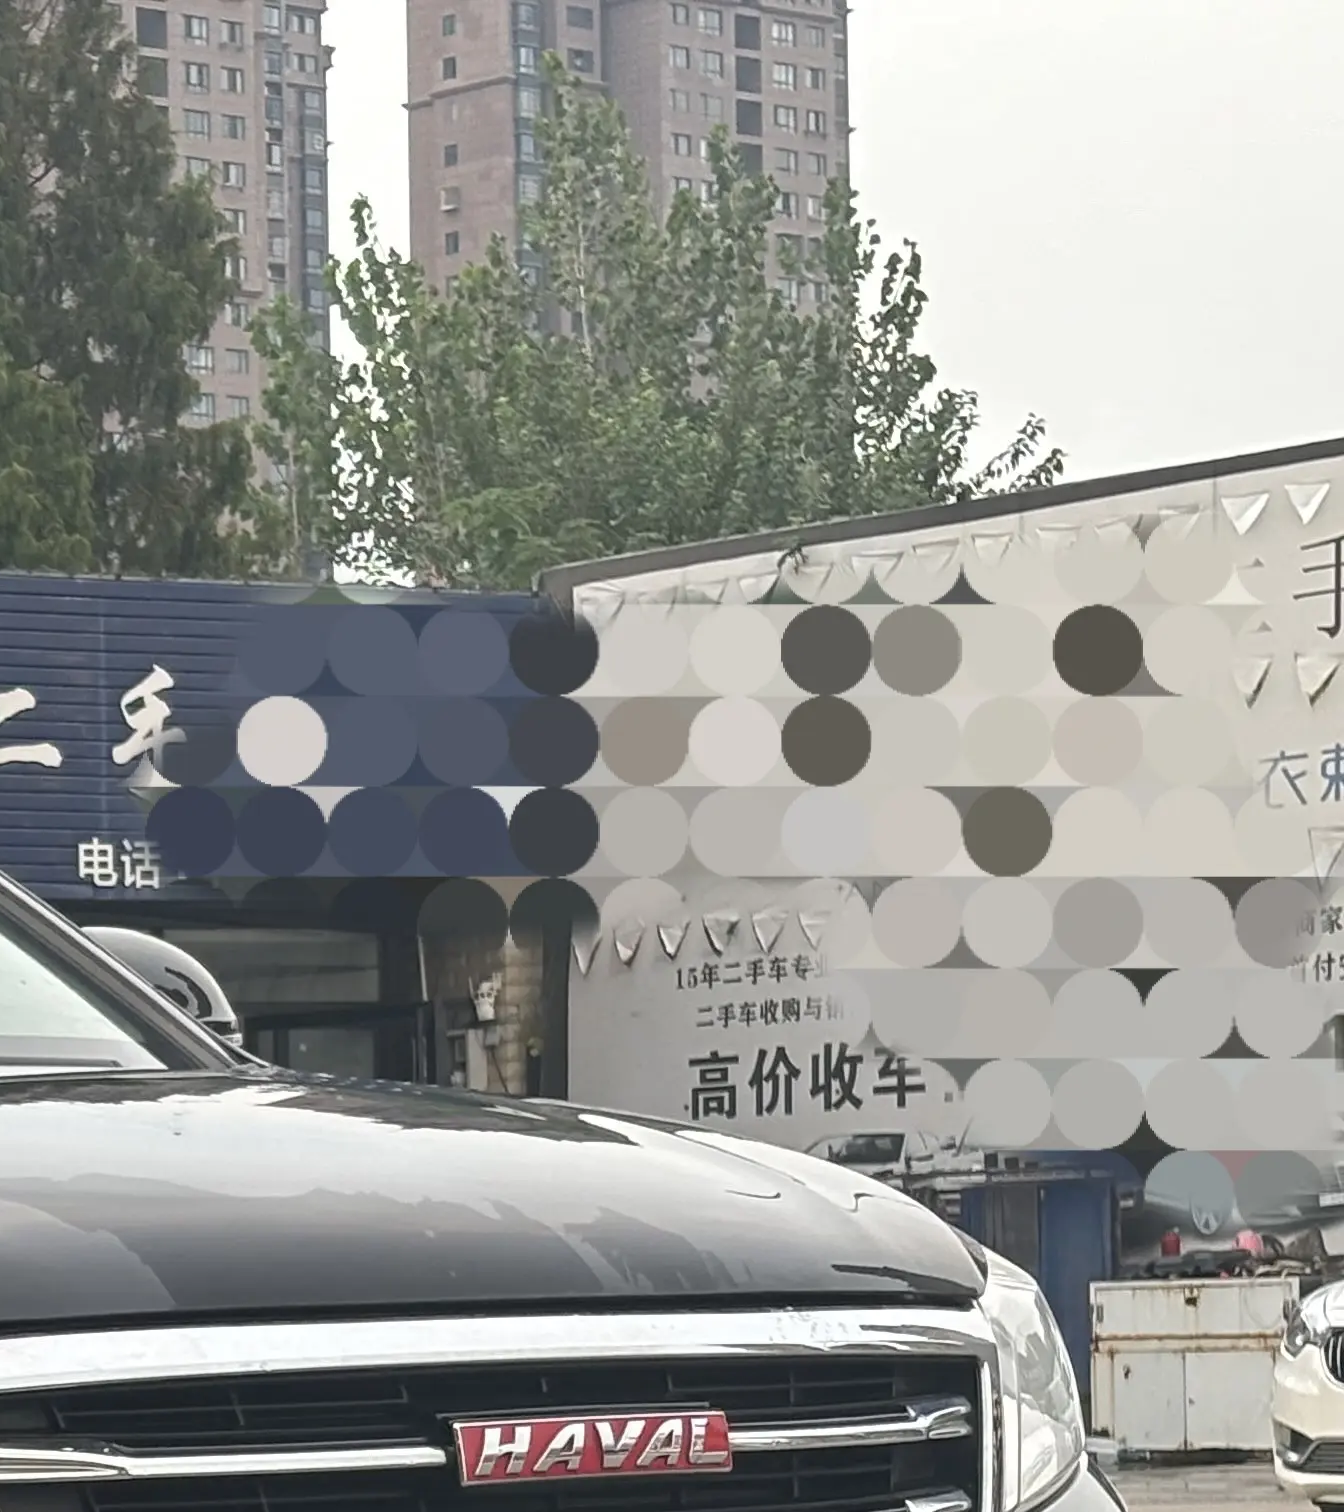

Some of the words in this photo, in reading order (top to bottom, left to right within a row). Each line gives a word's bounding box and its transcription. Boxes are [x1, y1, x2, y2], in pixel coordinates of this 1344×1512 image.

[77, 836, 162, 889] 电话
[688, 1042, 926, 1120] 高价收车
[474, 1417, 730, 1476] HAVAL
